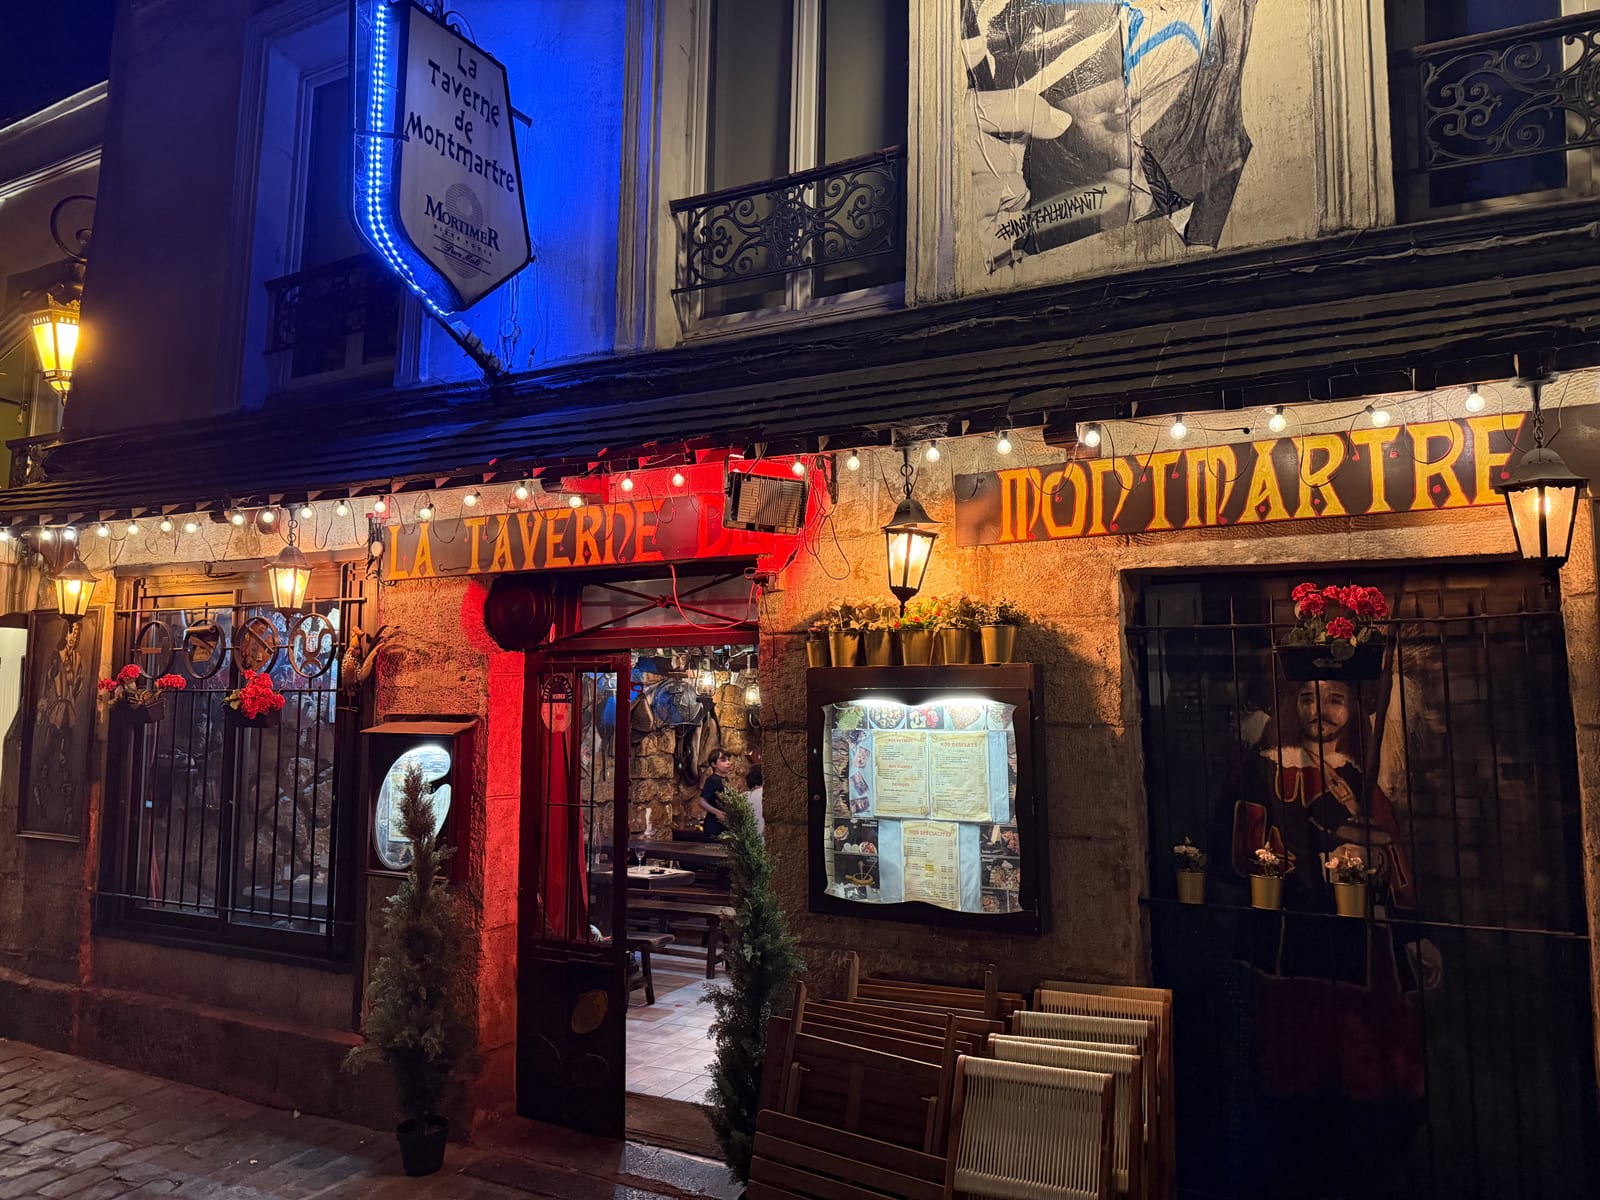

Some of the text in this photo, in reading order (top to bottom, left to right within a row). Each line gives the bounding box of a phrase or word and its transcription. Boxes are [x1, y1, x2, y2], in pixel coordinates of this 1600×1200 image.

[428, 58, 500, 128] Taverne
[457, 47, 478, 80] La
[405, 112, 514, 193] Montmartre
[454, 109, 473, 144] de
[424, 194, 500, 252] MORTIMER
[386, 522, 438, 579] LA
[463, 498, 666, 575] TAVERNE
[997, 413, 1527, 544] MONTMARTRE
